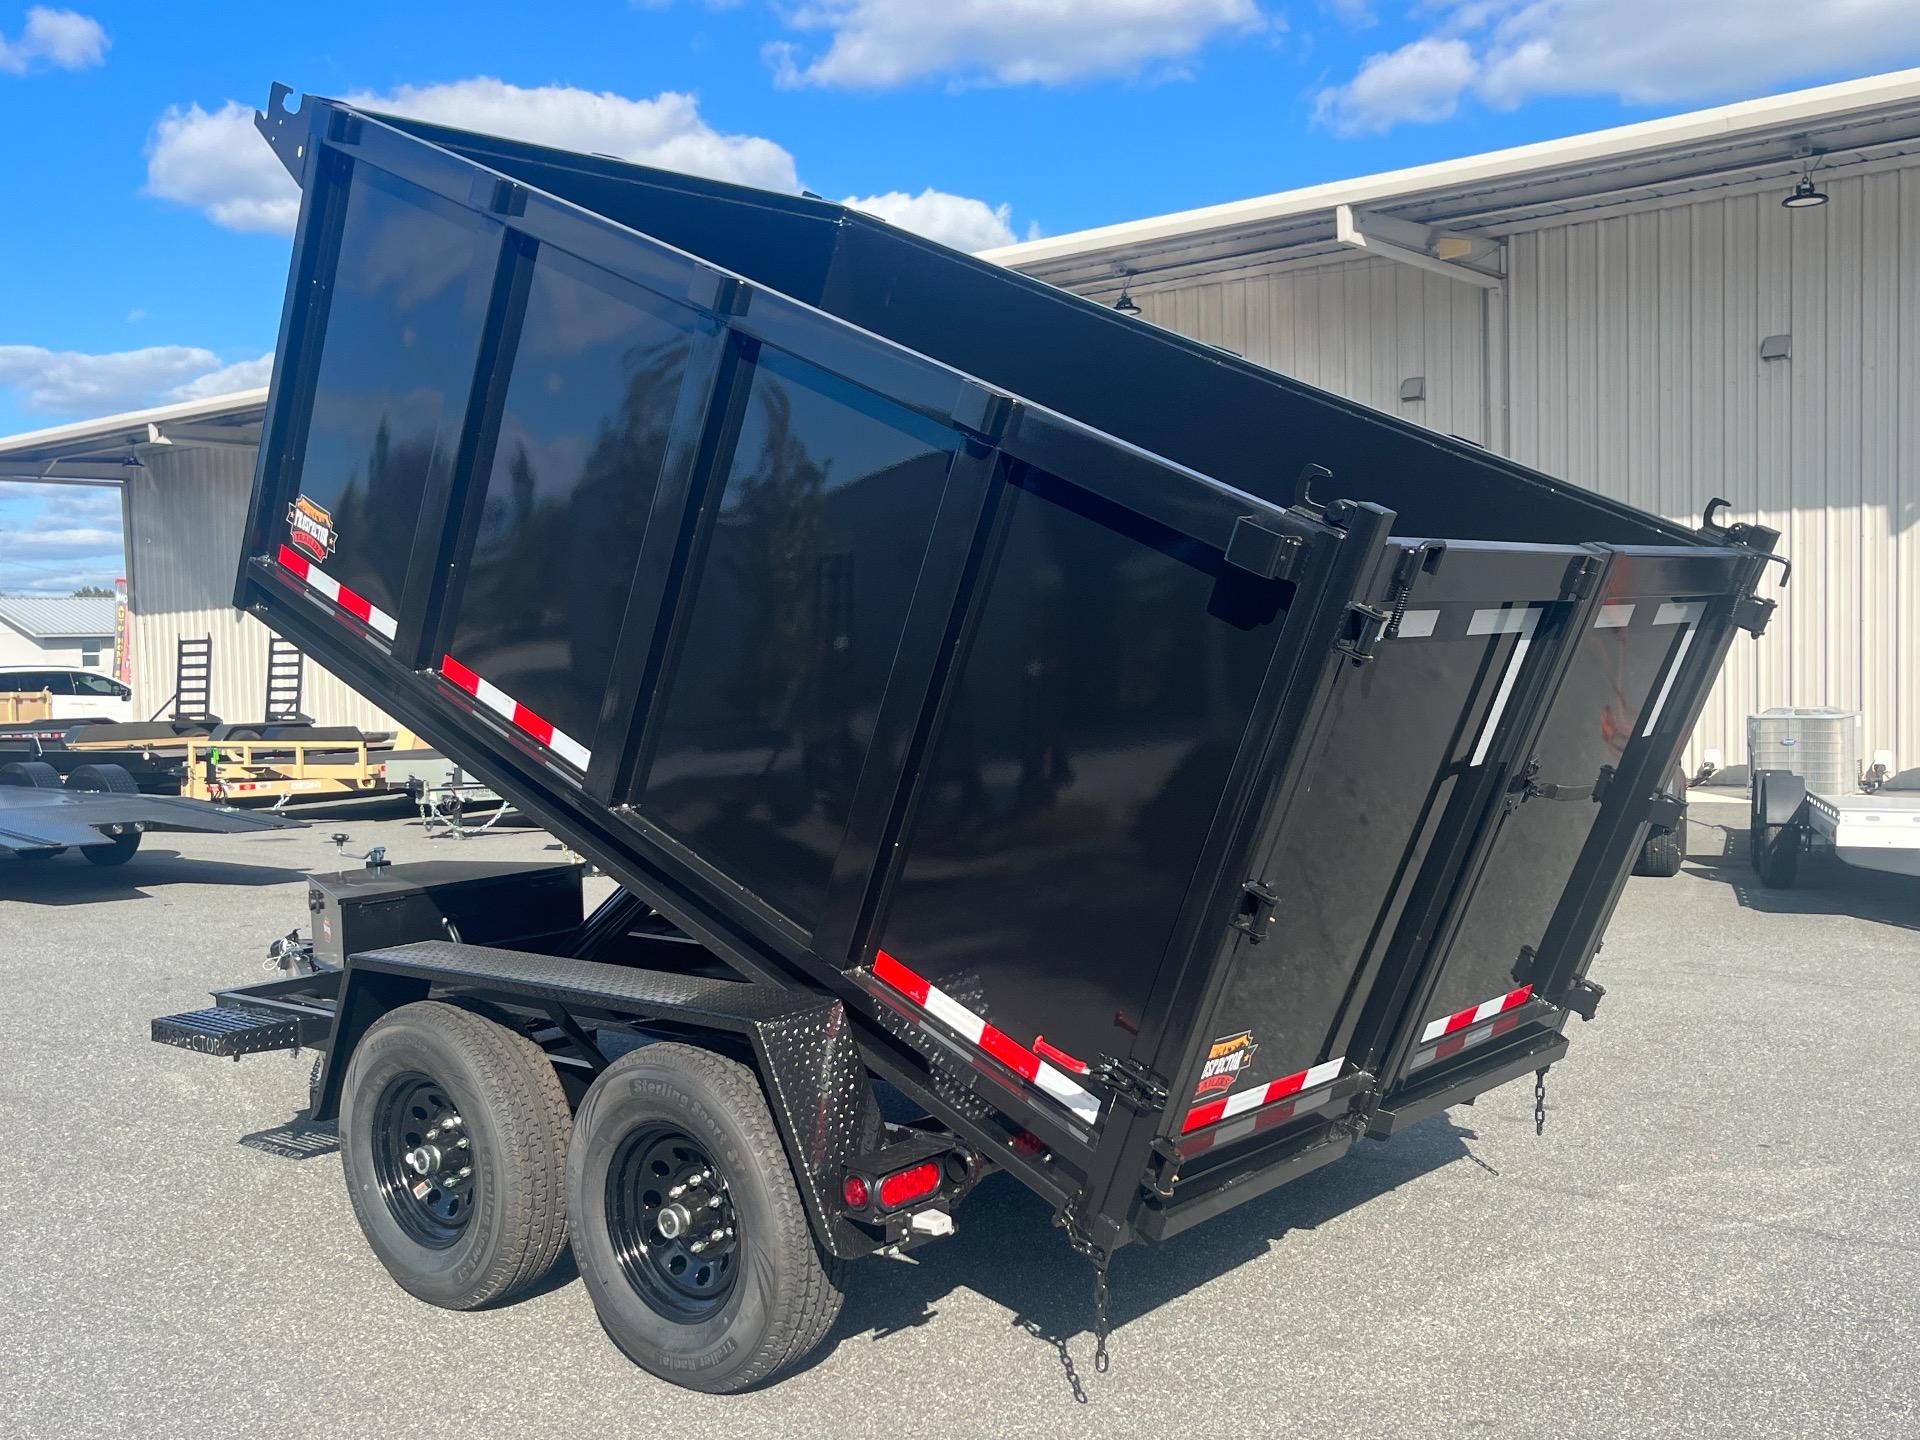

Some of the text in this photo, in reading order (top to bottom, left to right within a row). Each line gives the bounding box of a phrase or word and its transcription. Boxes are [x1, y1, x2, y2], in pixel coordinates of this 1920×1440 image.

[632, 1079, 689, 1109] Sterling
[690, 1101, 728, 1145] Sport
[699, 1339, 736, 1366] Trailer
